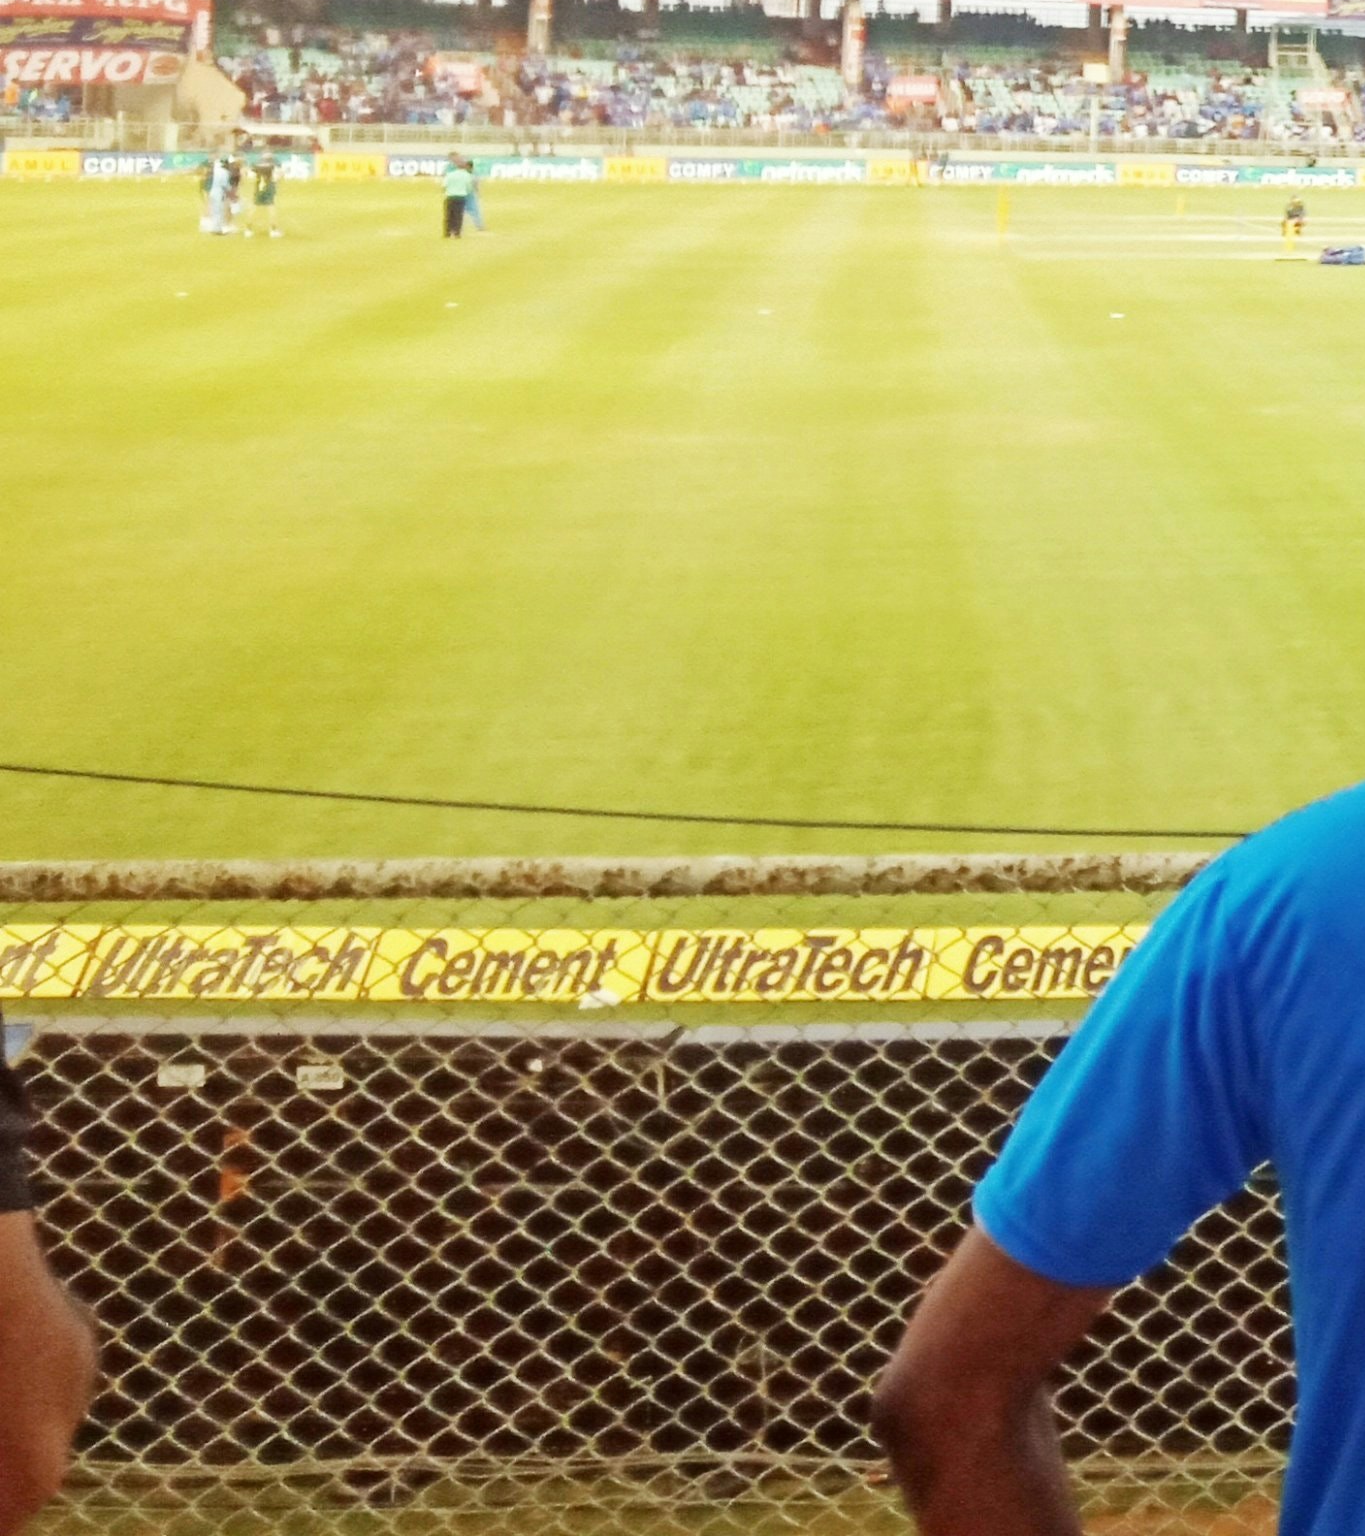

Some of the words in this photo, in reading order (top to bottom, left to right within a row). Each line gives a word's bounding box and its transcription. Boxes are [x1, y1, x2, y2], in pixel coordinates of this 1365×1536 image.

[1, 48, 142, 81] SERVO
[84, 157, 163, 174] COMFY
[389, 160, 447, 176] COMF
[669, 162, 734, 178] COMFY
[1176, 168, 1239, 183] COMFY
[90, 931, 368, 996] UltraTech
[400, 937, 618, 996] Cement
[658, 933, 928, 993] UltraTech
[962, 934, 1131, 994] Ceme
